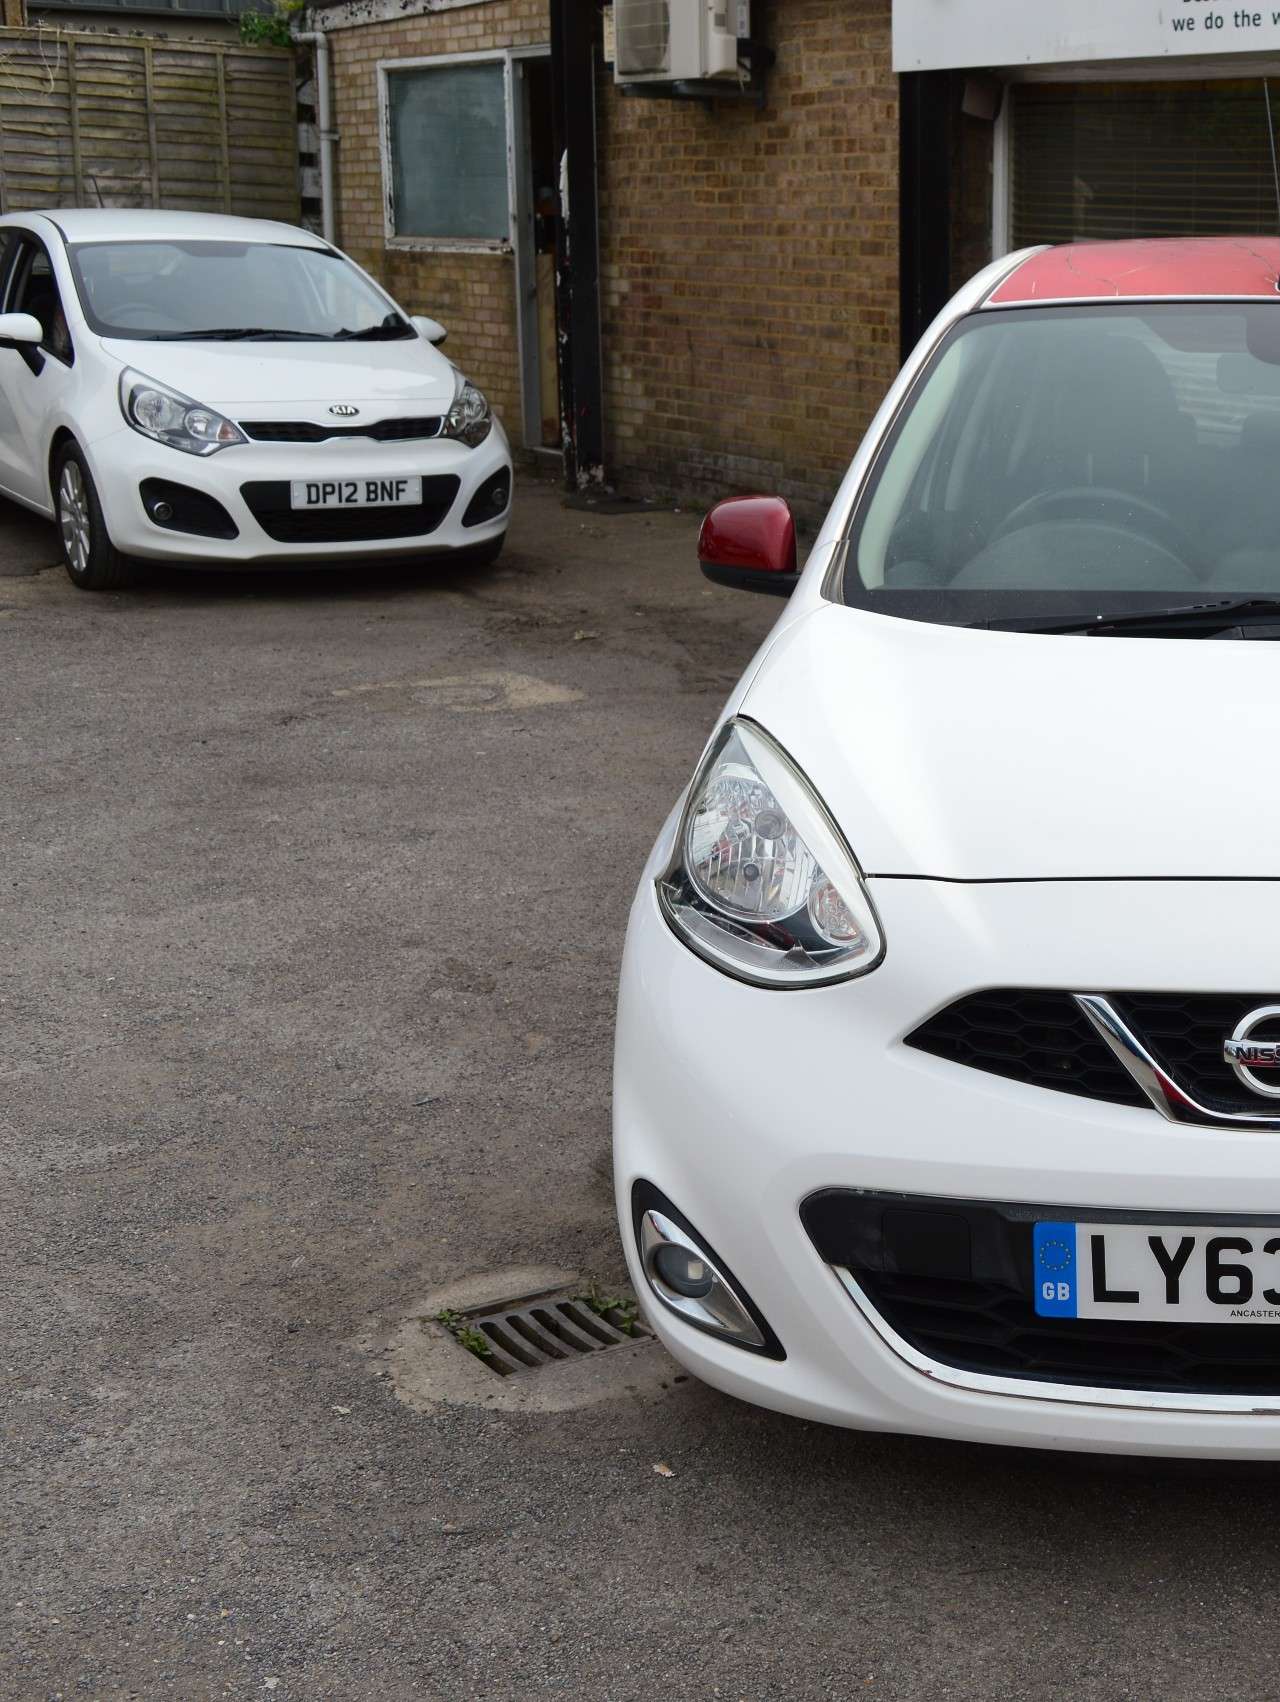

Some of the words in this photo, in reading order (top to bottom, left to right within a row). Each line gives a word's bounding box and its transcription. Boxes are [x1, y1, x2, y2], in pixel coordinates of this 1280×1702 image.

[1172, 16, 1195, 32] we
[1204, 12, 1224, 30] do
[1233, 10, 1262, 28] the
[331, 405, 356, 415] KIA
[306, 482, 358, 505] DP12
[365, 480, 408, 503] BNF
[1042, 1281, 1070, 1301] GB
[1230, 1309, 1280, 1318] ANCASTER
